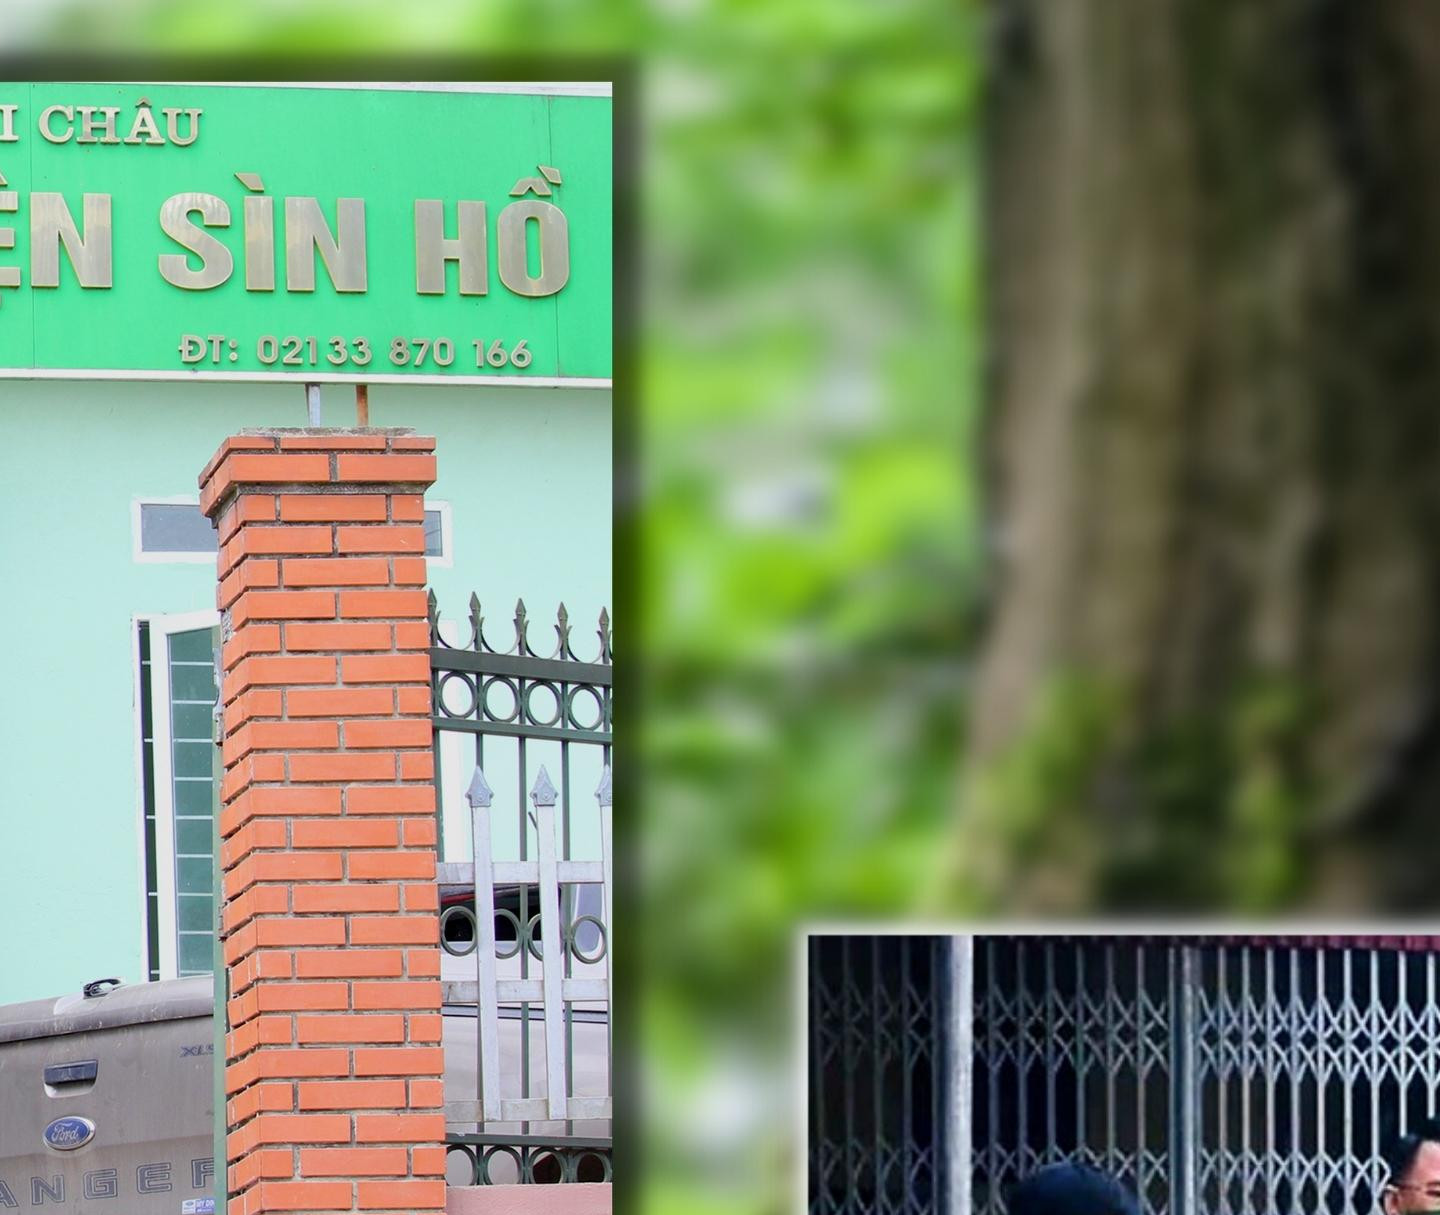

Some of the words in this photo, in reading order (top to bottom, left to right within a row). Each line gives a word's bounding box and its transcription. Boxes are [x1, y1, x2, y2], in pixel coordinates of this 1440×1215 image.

[38, 97, 203, 147] CHÂU
[158, 172, 368, 295] SÌN
[414, 165, 570, 299] HỒ
[178, 335, 239, 363] ĐT:
[388, 337, 456, 367] 870
[472, 339, 533, 369] 166
